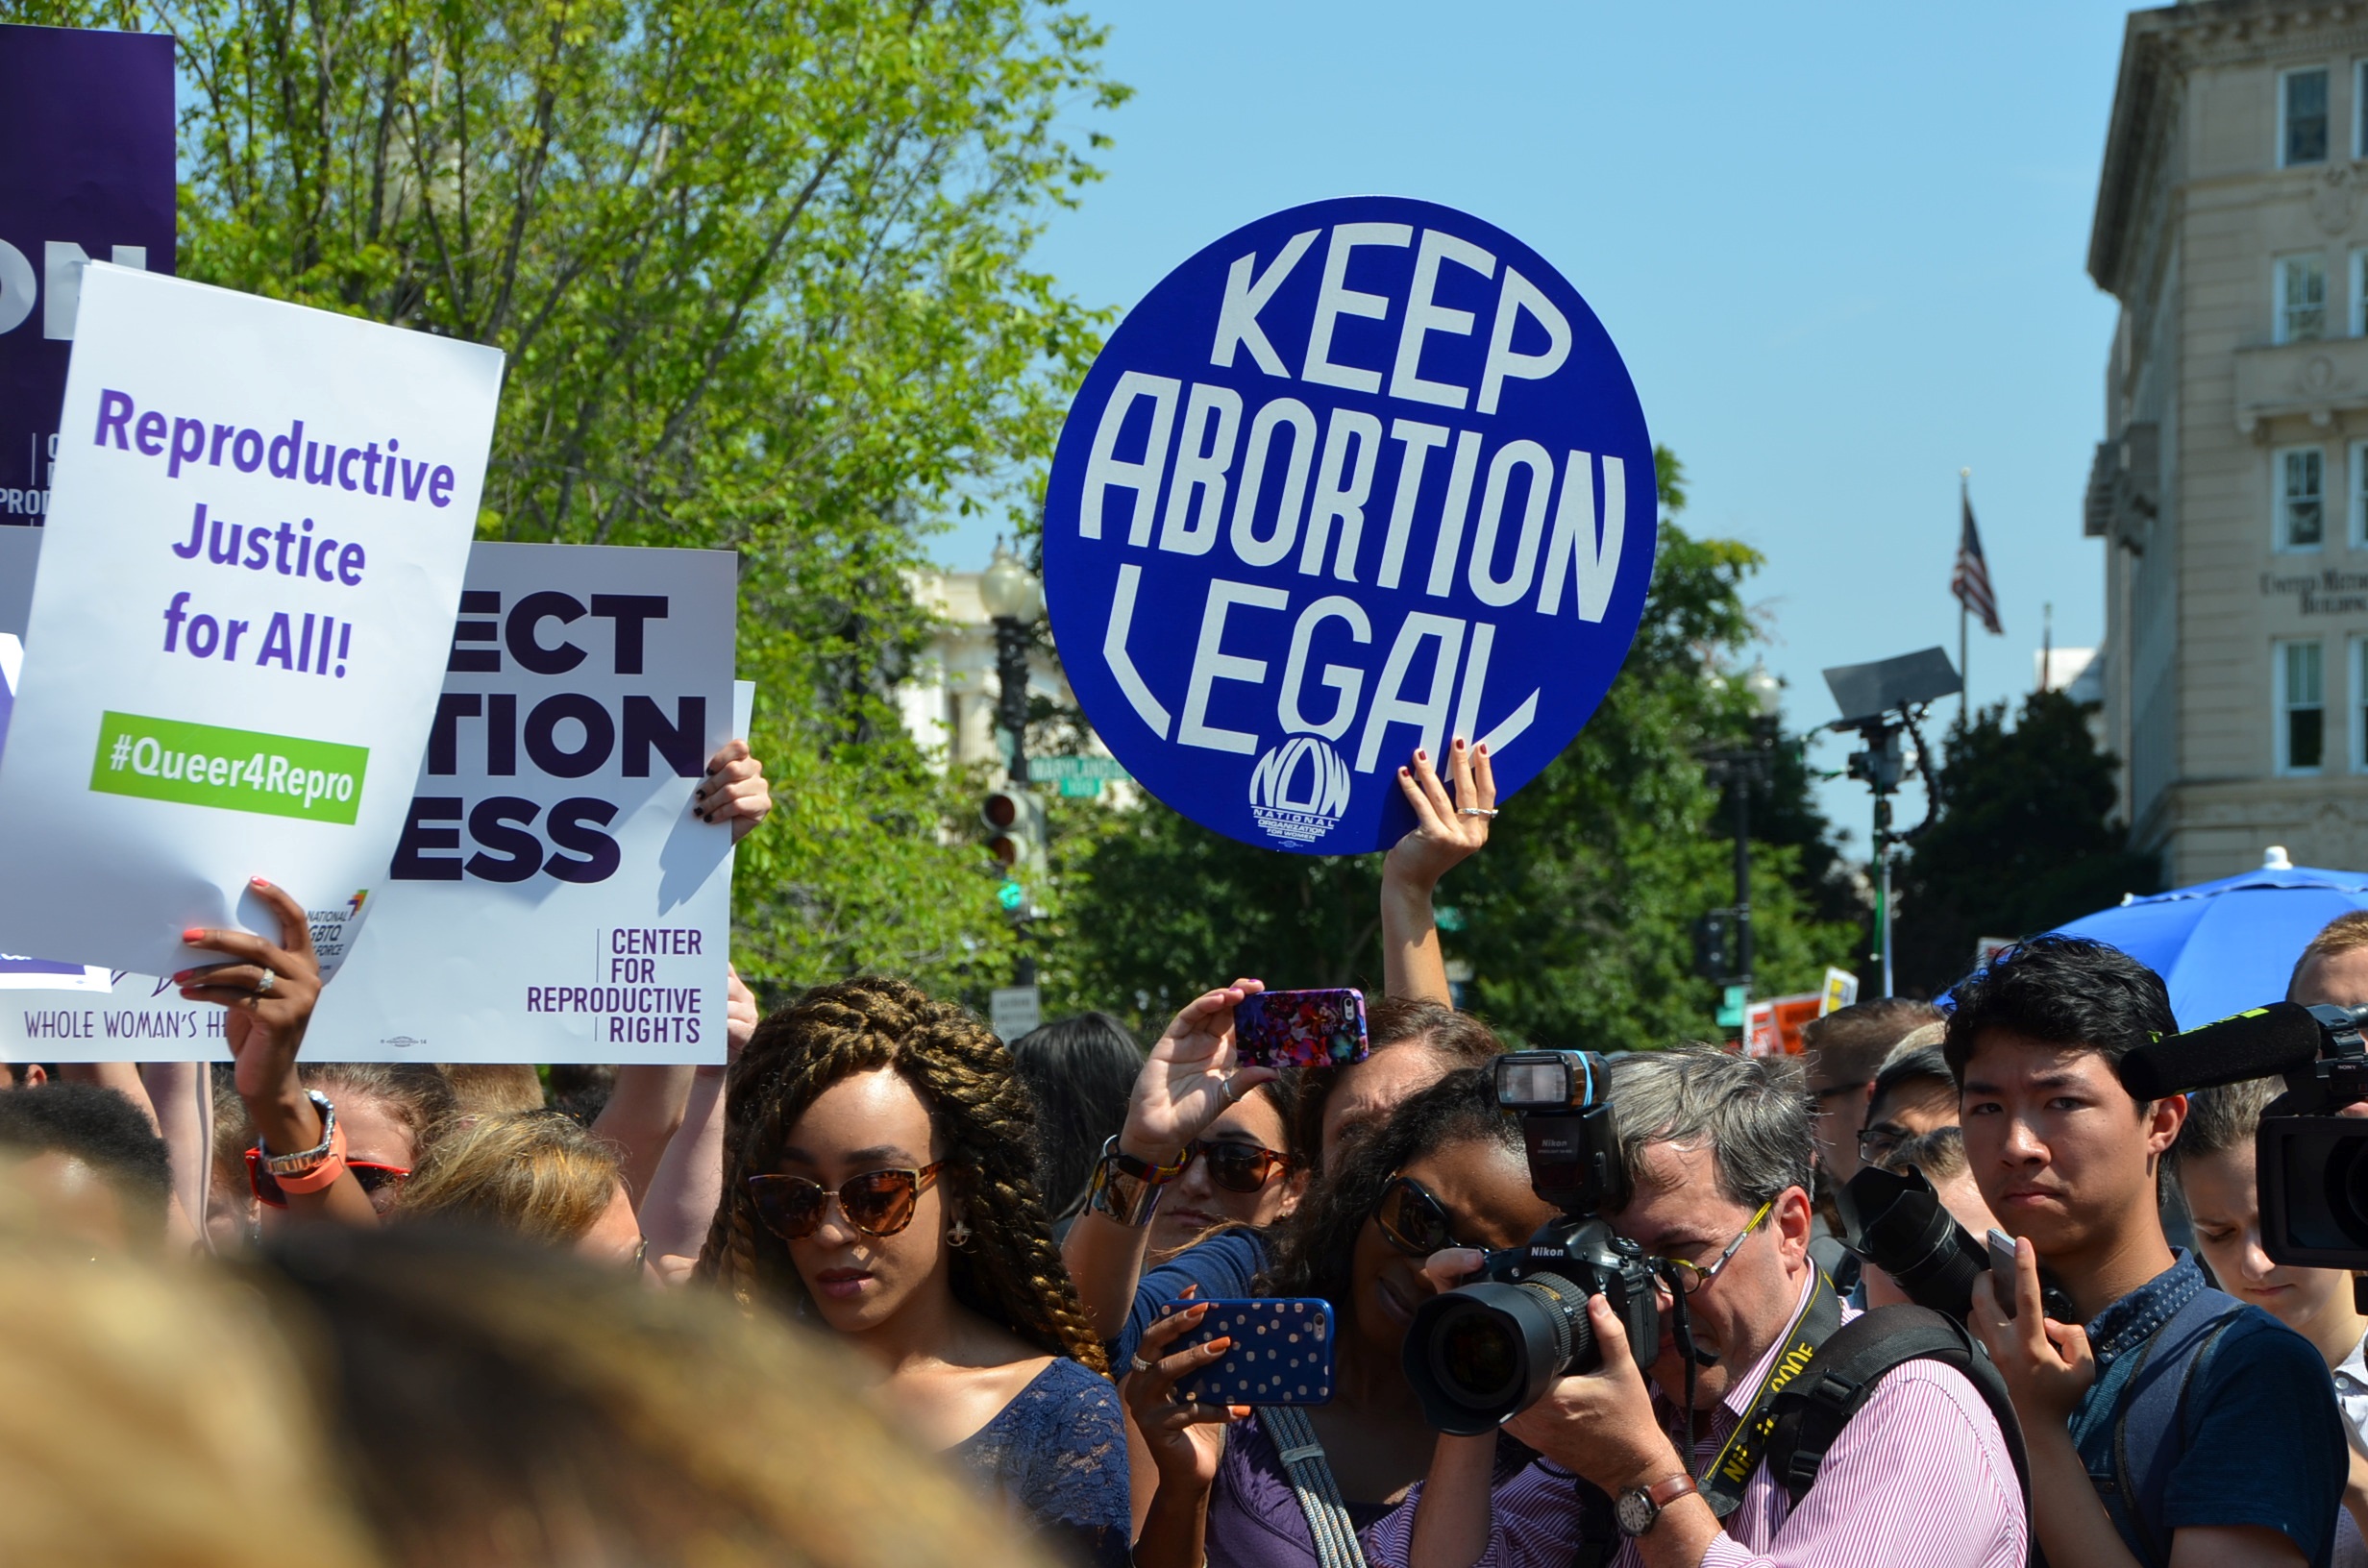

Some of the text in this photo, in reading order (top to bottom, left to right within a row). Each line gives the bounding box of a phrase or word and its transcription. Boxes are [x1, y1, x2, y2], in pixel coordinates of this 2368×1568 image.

[1210, 222, 1572, 415] KEEP
[93, 388, 455, 508] Reproductive
[1079, 370, 1626, 624] ABORTION
[171, 502, 365, 587] Justice
[162, 591, 352, 678] for All!
[1102, 563, 1540, 783] LEGAL
[428, 693, 706, 778] TION
[110, 733, 354, 809] #Queer4Repro
[1249, 737, 1351, 819] NOW
[1253, 808, 1335, 827] NATIONAL
[1257, 819, 1326, 835] ORGANIZATION
[389, 796, 622, 884] ESS
[1284, 830, 1317, 841] WOMEN
[306, 911, 349, 923] NATIONAL
[611, 928, 703, 955] CENTER
[610, 957, 655, 984] FOR
[527, 986, 702, 1014] REPRODUCTIVE
[24, 1010, 94, 1039] WHOLE
[103, 1010, 197, 1039] WOMAN'S
[609, 1016, 702, 1044] RIGHTS
[1542, 1139, 1568, 1148] Nikon
[1531, 1246, 1565, 1257] Nikon
